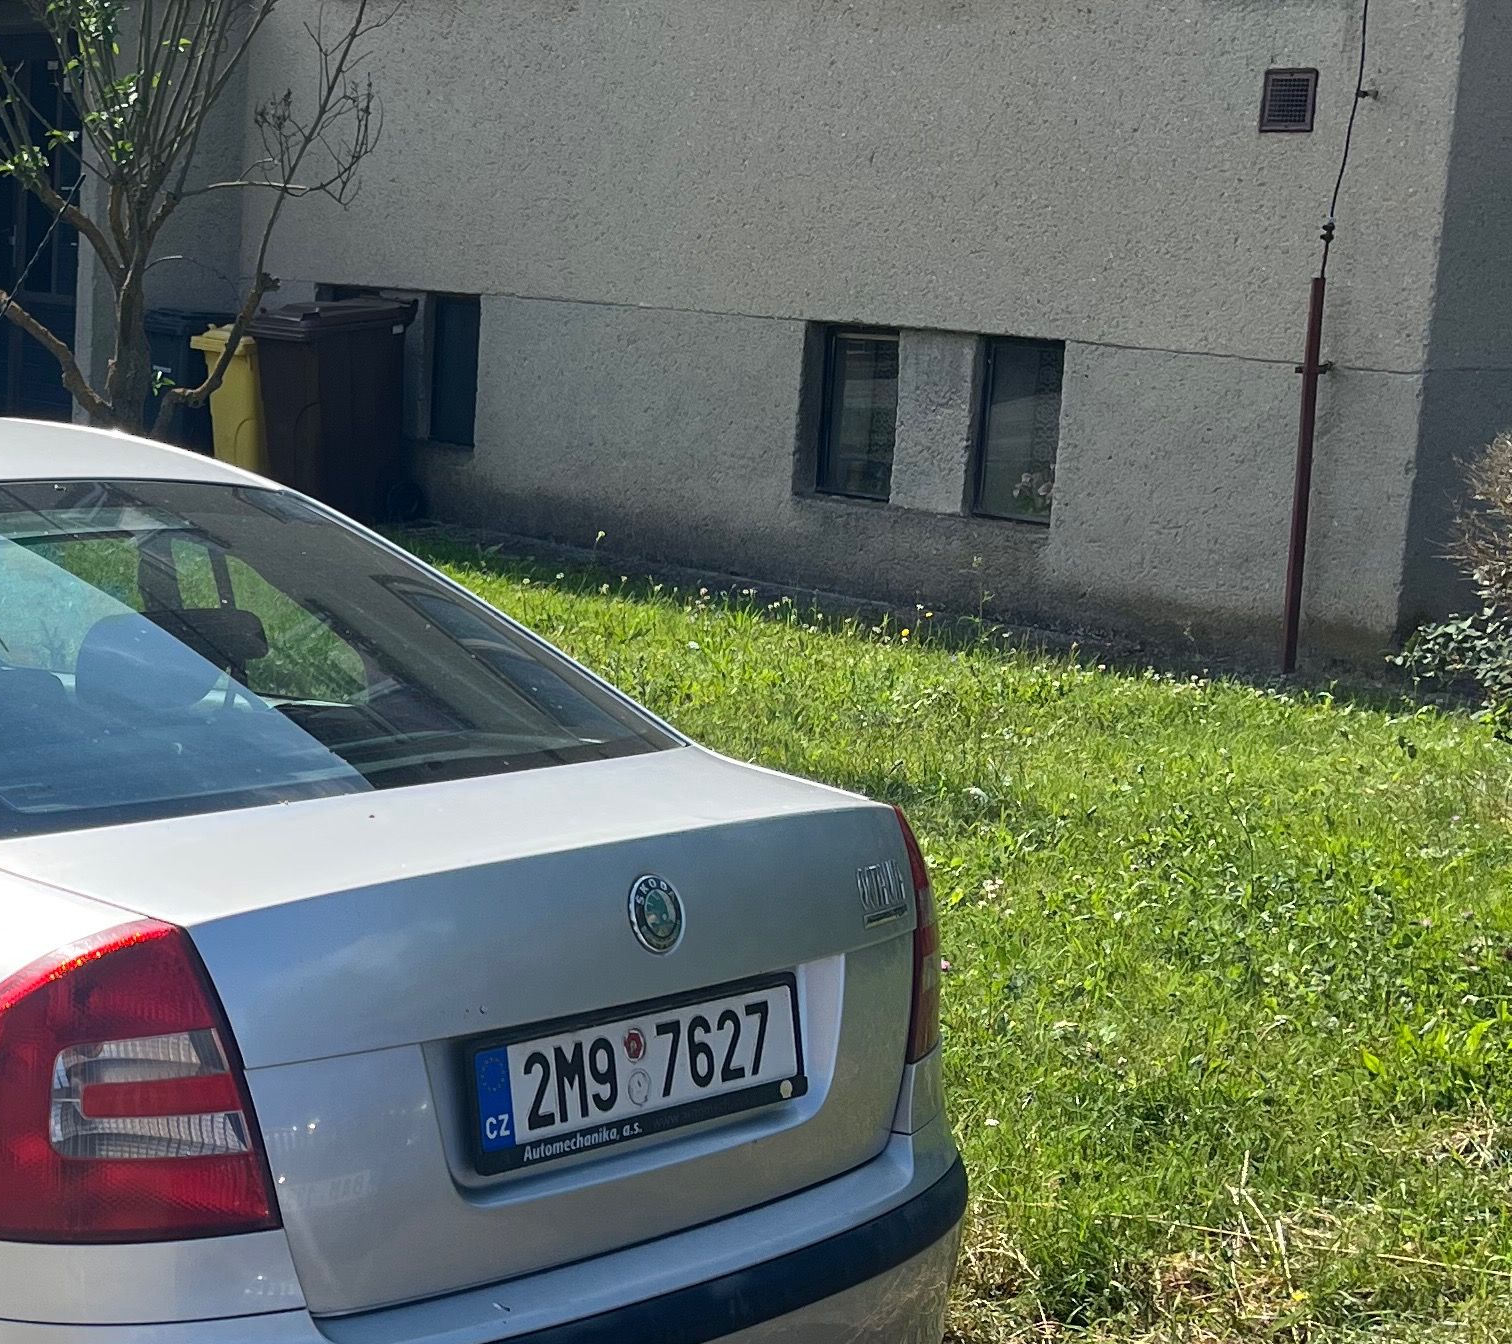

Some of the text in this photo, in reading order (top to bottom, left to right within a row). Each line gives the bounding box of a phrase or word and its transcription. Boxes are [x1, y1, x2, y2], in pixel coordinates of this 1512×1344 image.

[523, 1000, 769, 1131] 2M9 7627
[485, 1113, 510, 1139] CZ
[523, 1122, 643, 1162] Automechanika, a.s.
